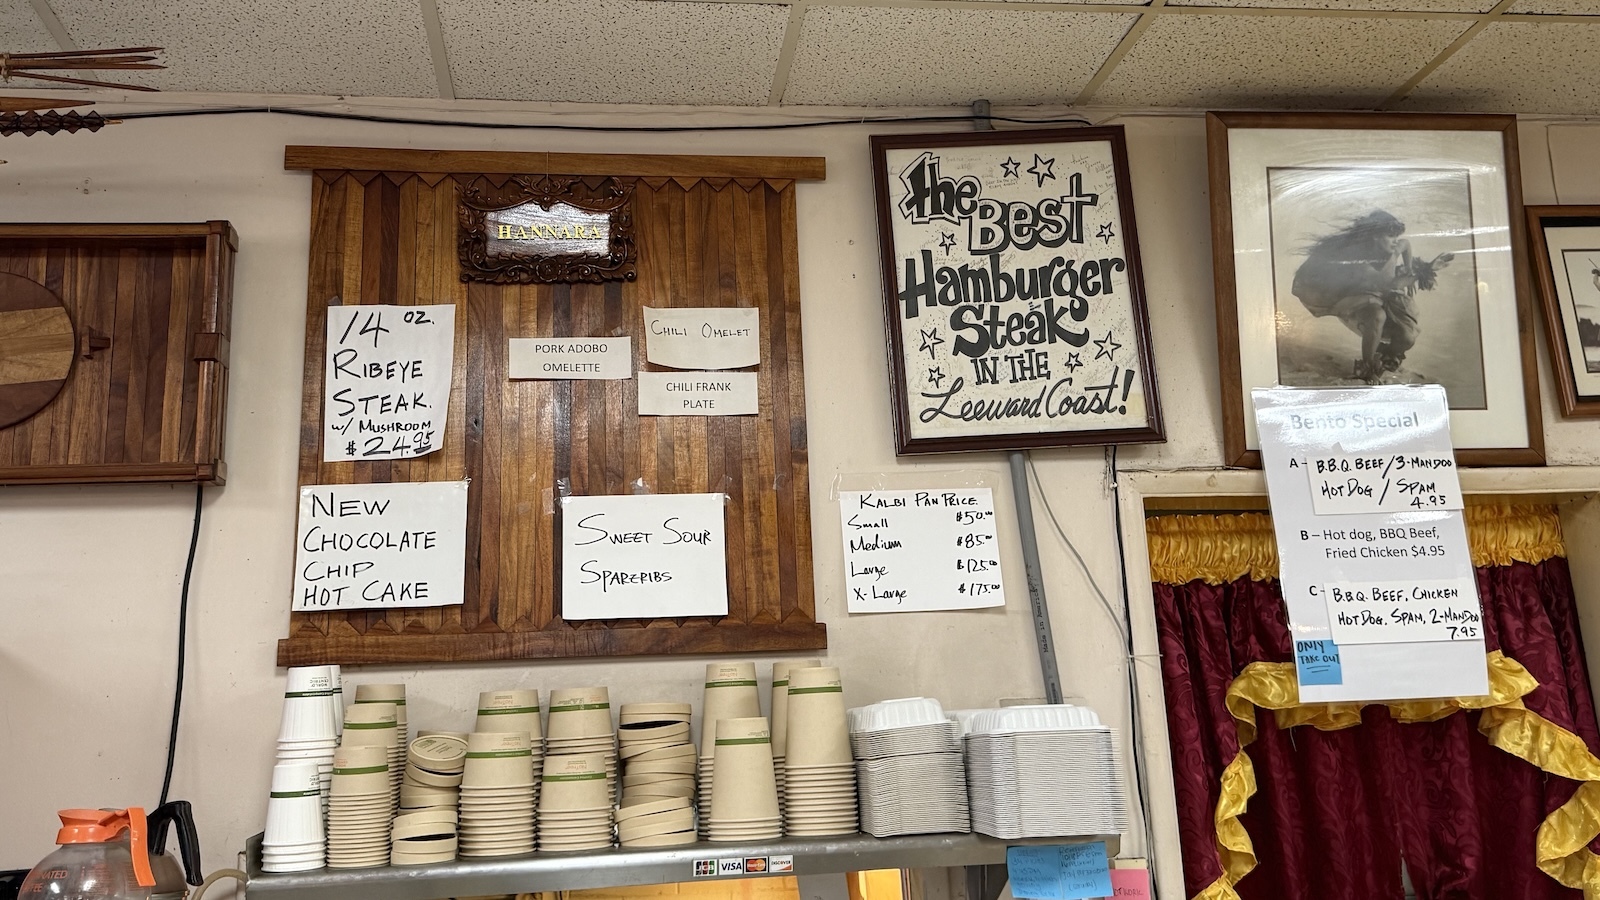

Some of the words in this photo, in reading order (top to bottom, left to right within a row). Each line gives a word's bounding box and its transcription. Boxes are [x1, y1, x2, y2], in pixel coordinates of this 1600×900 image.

[899, 152, 982, 225] the
[968, 173, 1099, 255] Best
[498, 225, 602, 240] HANNARA
[899, 248, 1125, 321] Hamburger
[339, 311, 390, 348] 14
[650, 319, 687, 337] CHILI
[702, 322, 751, 338] OMELET
[950, 299, 1089, 358] Steak
[535, 345, 565, 354] PORK
[568, 344, 608, 353] ADOBO
[333, 348, 424, 383] RIBEYE
[543, 363, 601, 372] OMELETTE
[970, 357, 1000, 385] IN
[1005, 349, 1051, 384] THE
[666, 383, 693, 392] CHILI
[696, 382, 731, 392] FRANK
[920, 377, 1047, 423] Leeward
[1046, 366, 1135, 419] Coast!
[332, 388, 432, 417] STEAK.
[683, 400, 715, 409] PLATE
[332, 417, 354, 435] w/
[359, 419, 431, 433] MUSHROOM
[1290, 415, 1347, 430] Bento
[1352, 411, 1419, 431] Special
[1289, 459, 1298, 468] A
[1321, 481, 1344, 499] HOT
[1347, 478, 1373, 498] DOG
[1396, 478, 1436, 494] SPAM
[312, 492, 390, 517] NEW
[860, 493, 906, 509] KALBI
[915, 492, 938, 507] PAN
[1410, 496, 1446, 509] 4.95
[575, 513, 653, 546] SWEET
[663, 518, 712, 546] SOUR
[848, 514, 888, 530] Small
[303, 526, 437, 552] CHOCOLATE
[850, 534, 902, 553] Medium
[1301, 531, 1309, 540] B
[1323, 530, 1347, 540] Hot
[1349, 528, 1376, 542] dog,
[1380, 528, 1407, 540] BBQ
[1410, 527, 1440, 540] Beef,
[1325, 547, 1357, 559] Fried
[1360, 547, 1408, 558] Chicken
[1411, 546, 1446, 558] $4.95
[303, 561, 374, 582] CHIP
[850, 561, 889, 581] Large
[303, 585, 350, 607] HOT
[362, 580, 428, 602] CAKE
[1309, 586, 1318, 596] C
[1412, 587, 1458, 600] CHICKEN
[1338, 611, 1359, 626] HOT
[1447, 627, 1477, 640] 7.95
[1298, 641, 1325, 653] ONLY
[1298, 655, 1320, 664] TAKE
[1323, 654, 1340, 664] OUT
[722, 863, 742, 871] VISA
